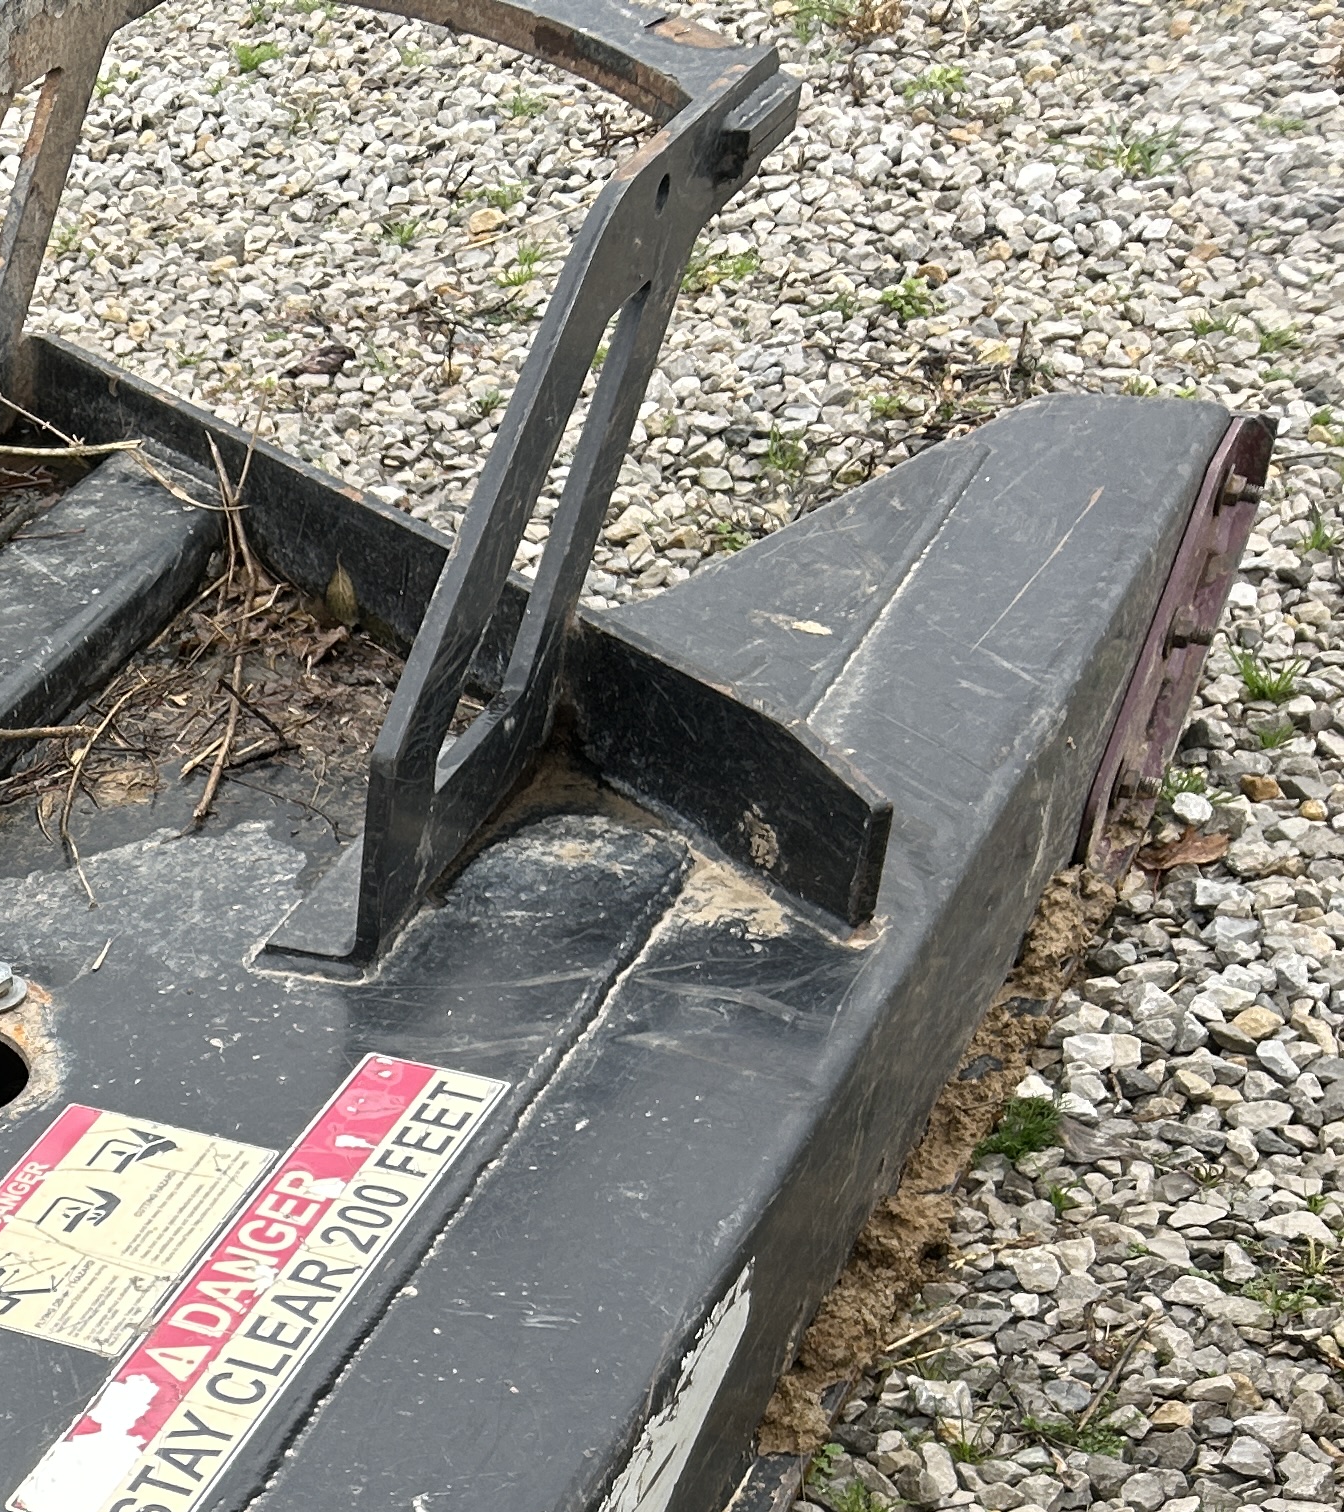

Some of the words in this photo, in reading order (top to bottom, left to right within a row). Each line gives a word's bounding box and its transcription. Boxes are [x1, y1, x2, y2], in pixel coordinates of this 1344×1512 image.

[187, 1168, 330, 1338] DANGER
[207, 1256, 359, 1405] CLEAR
[336, 1184, 409, 1255] 200
[376, 1081, 487, 1180] FEET
